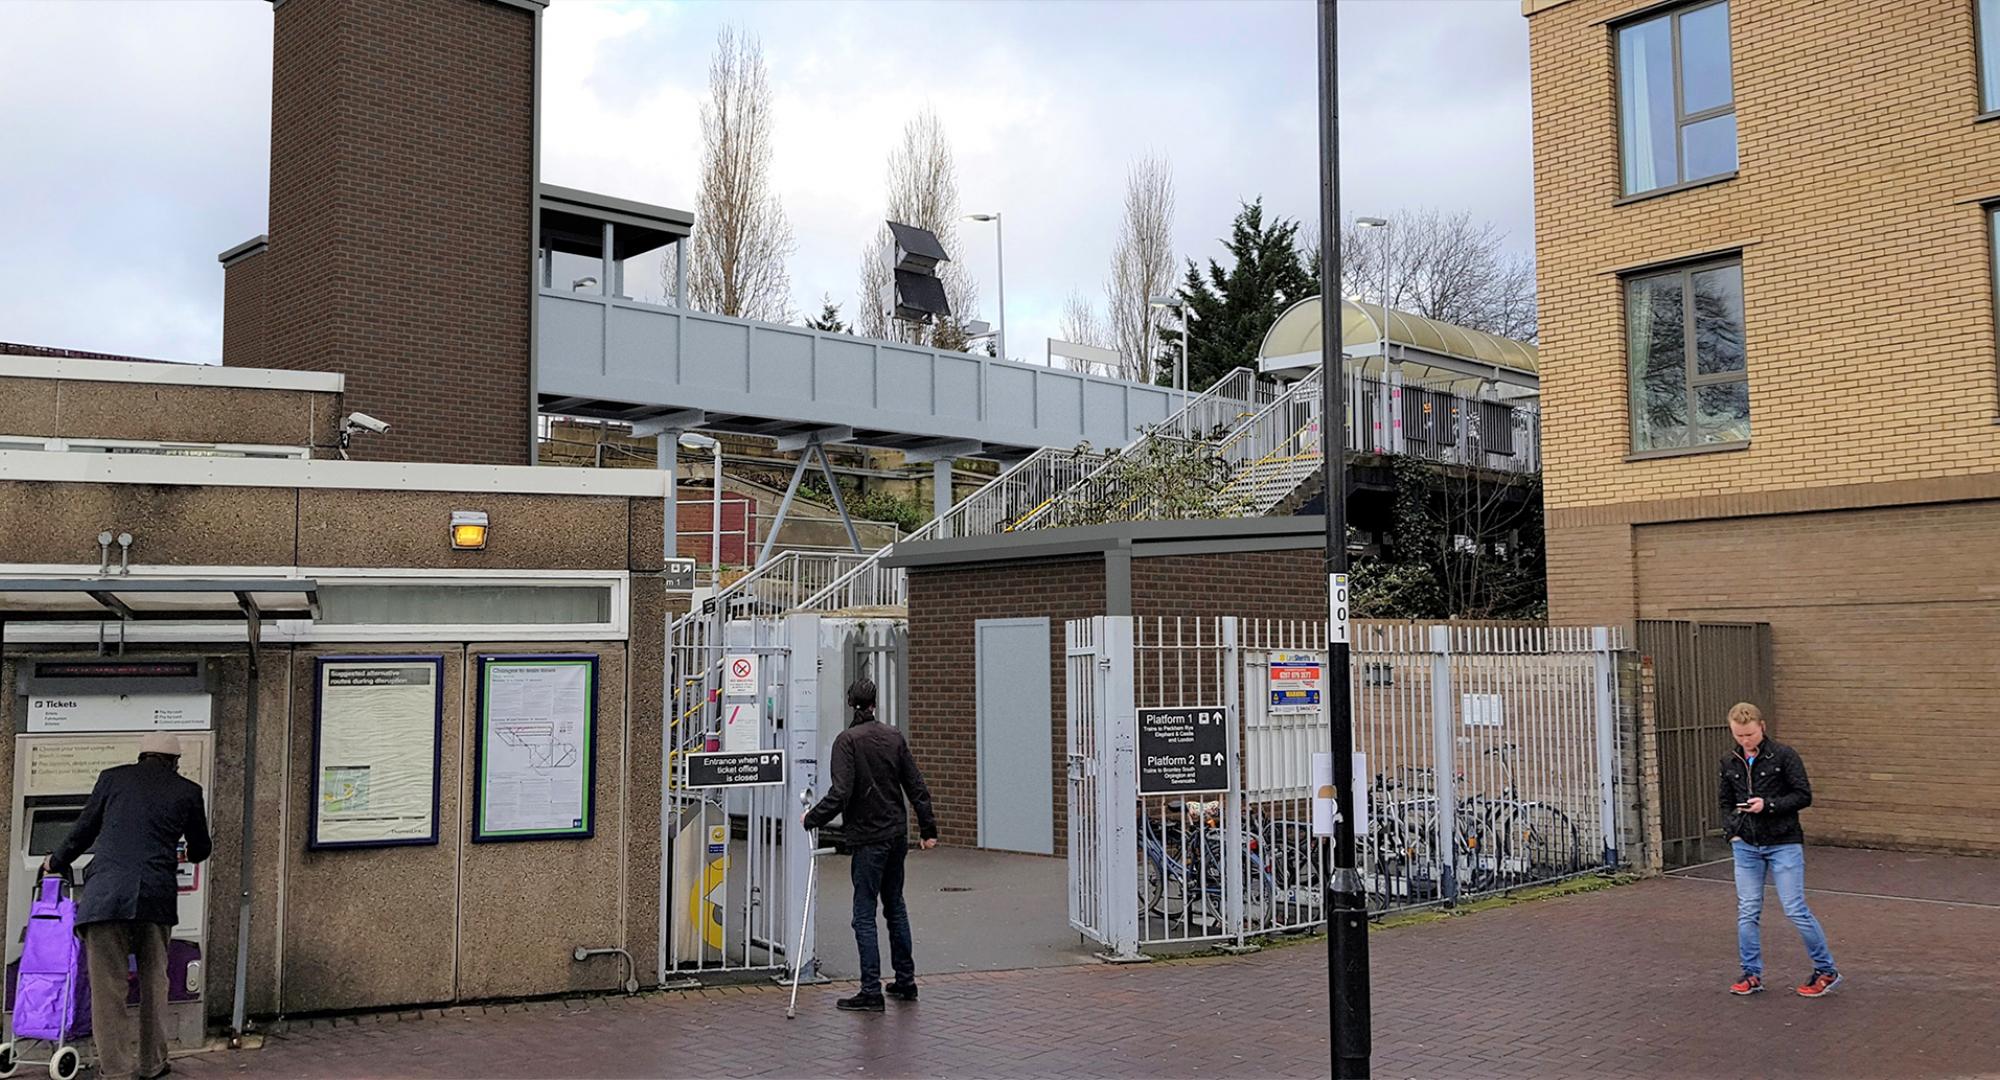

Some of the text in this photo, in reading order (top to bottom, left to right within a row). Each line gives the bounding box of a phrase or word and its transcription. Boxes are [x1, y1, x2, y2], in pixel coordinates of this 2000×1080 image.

[1337, 588, 1346, 640] 001
[330, 670, 366, 678] Suggested
[45, 700, 77, 709] Tickets
[1146, 714, 1193, 724] Platform 1
[703, 756, 758, 765] Entrance when
[1147, 755, 1195, 766] Platform 2
[717, 765, 758, 773] ticket office
[734, 774, 758, 782] closed
